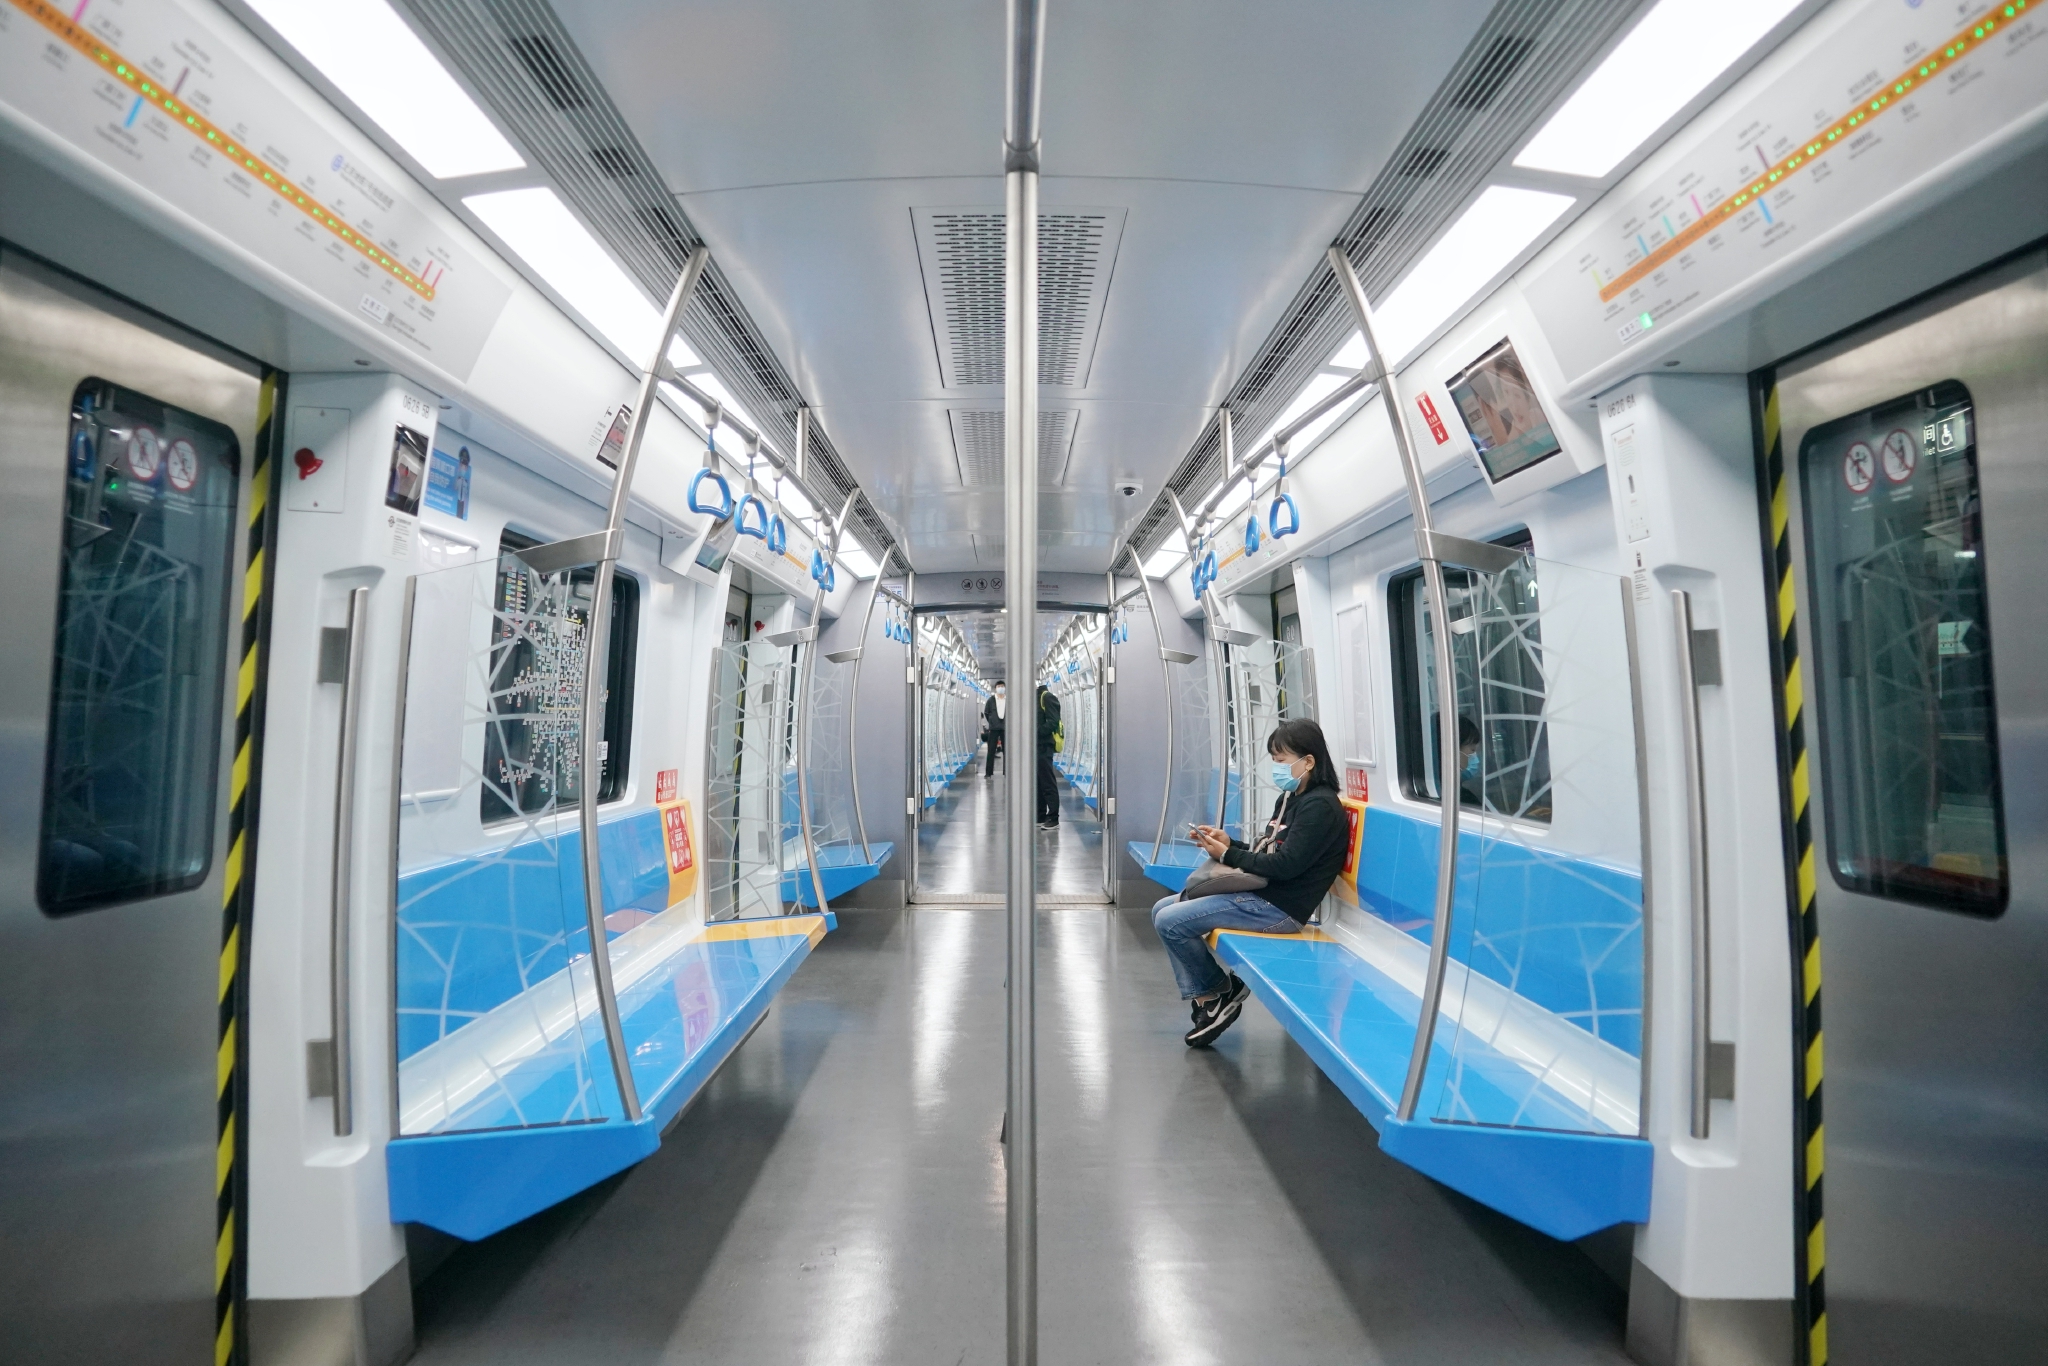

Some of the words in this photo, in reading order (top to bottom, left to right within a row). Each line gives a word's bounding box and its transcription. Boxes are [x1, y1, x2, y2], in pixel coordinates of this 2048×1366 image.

[402, 395, 420, 414] 0626
[421, 404, 430, 419] 5B
[1607, 398, 1625, 418] 0626
